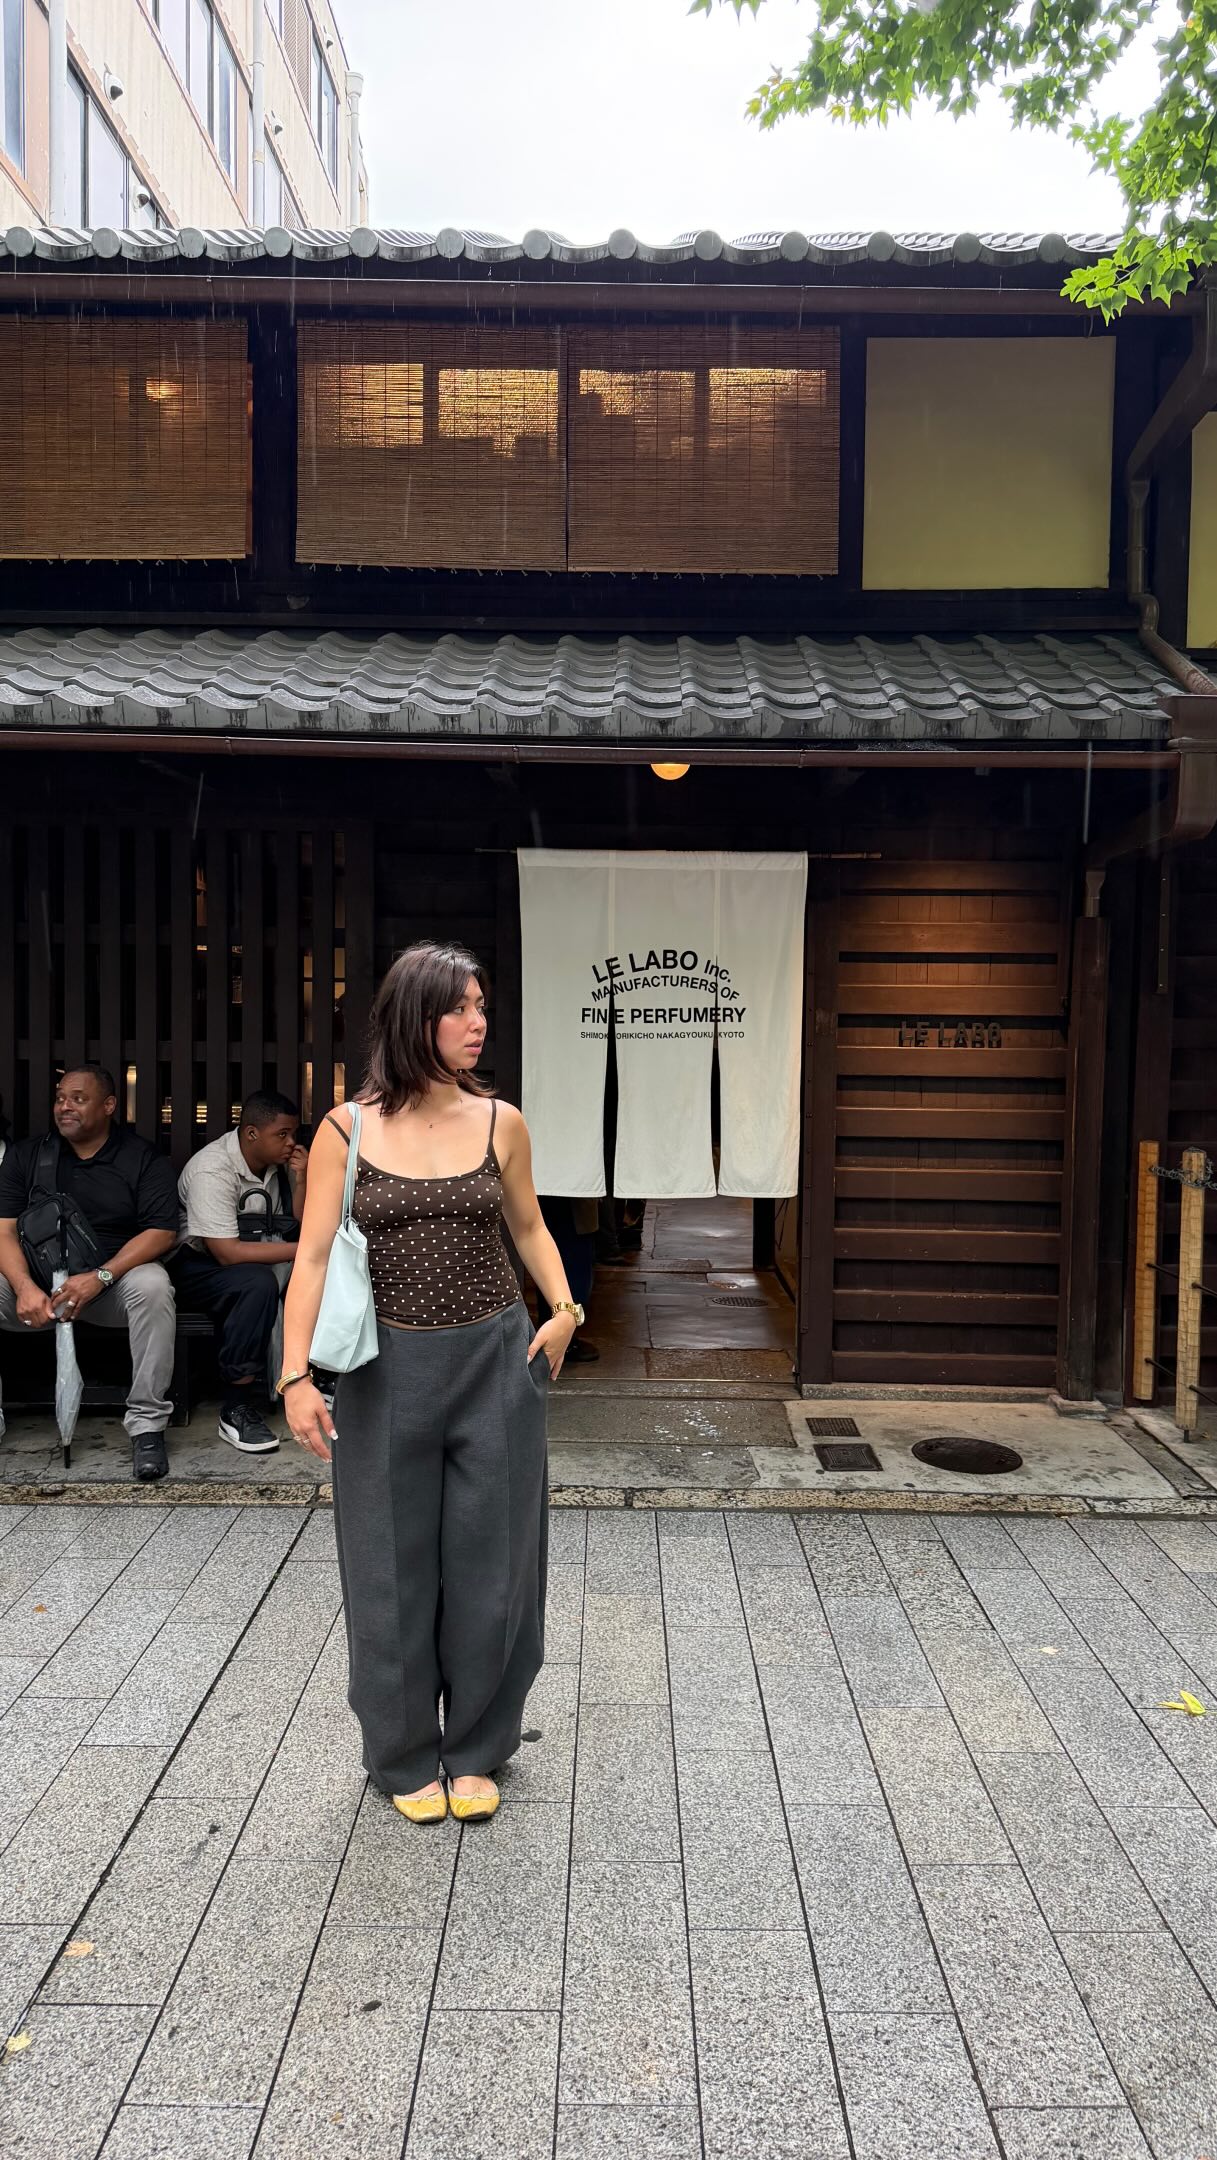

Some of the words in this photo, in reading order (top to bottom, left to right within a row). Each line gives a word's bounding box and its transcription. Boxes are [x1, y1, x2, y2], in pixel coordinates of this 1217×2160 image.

[592, 956, 625, 984] LE
[628, 949, 699, 973] LABO
[704, 959, 731, 983] Inc.
[591, 975, 719, 1003] MANUFACTURERS
[720, 986, 740, 1001] OF
[581, 1007, 625, 1024] FINE
[630, 1007, 747, 1024] PERFUMERY
[900, 1020, 930, 1045] LE
[939, 1021, 1001, 1046] LABO
